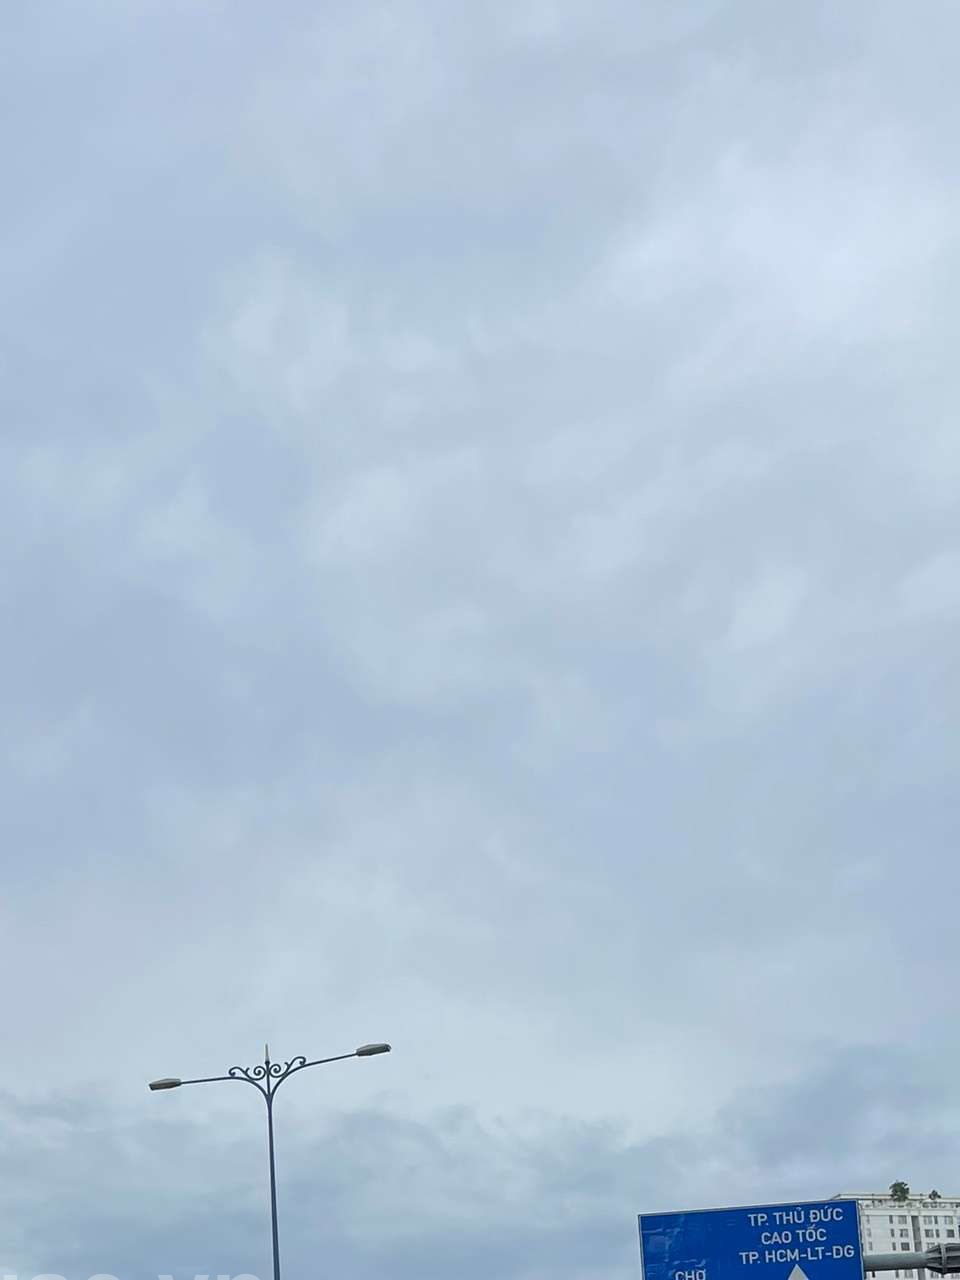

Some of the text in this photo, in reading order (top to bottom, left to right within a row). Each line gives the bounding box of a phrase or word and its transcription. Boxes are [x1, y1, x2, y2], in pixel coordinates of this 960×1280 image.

[747, 1205, 844, 1227] TP. THỦ ĐỨC
[761, 1224, 827, 1245] CAO TỐC
[739, 1245, 855, 1265] TP. HCM-LT-DG
